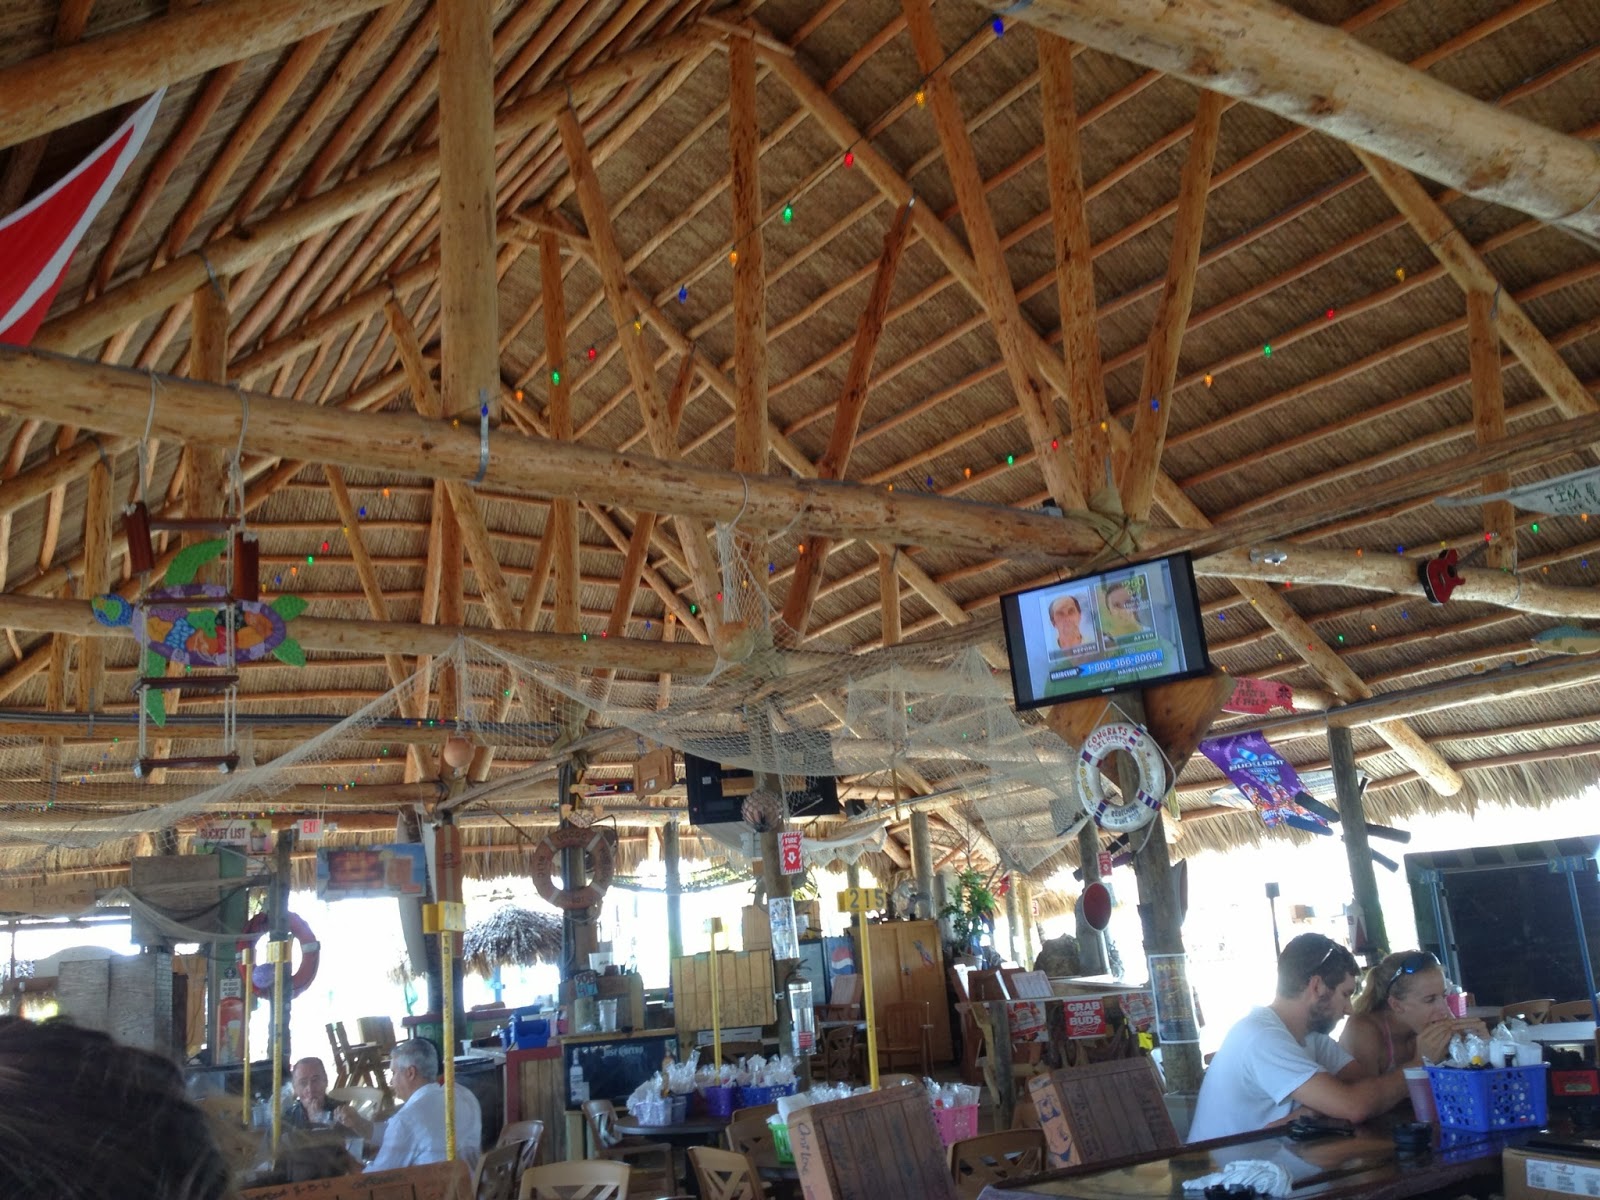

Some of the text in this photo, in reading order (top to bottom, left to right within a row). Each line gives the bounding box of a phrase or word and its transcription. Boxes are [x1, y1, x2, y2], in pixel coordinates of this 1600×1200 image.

[1545, 488, 1582, 506] TIM
[1134, 632, 1154, 641] AFTER
[1072, 645, 1096, 655] BEFORE
[1087, 726, 1128, 749] CONGRATS
[1256, 759, 1284, 768] LIGHT
[303, 820, 320, 834] EXIT
[230, 827, 246, 839] LIST
[784, 836, 798, 844] FIRE
[849, 888, 885, 909] 215
[1068, 1001, 1100, 1012] GRAB
[1069, 1015, 1101, 1026] BUDS
